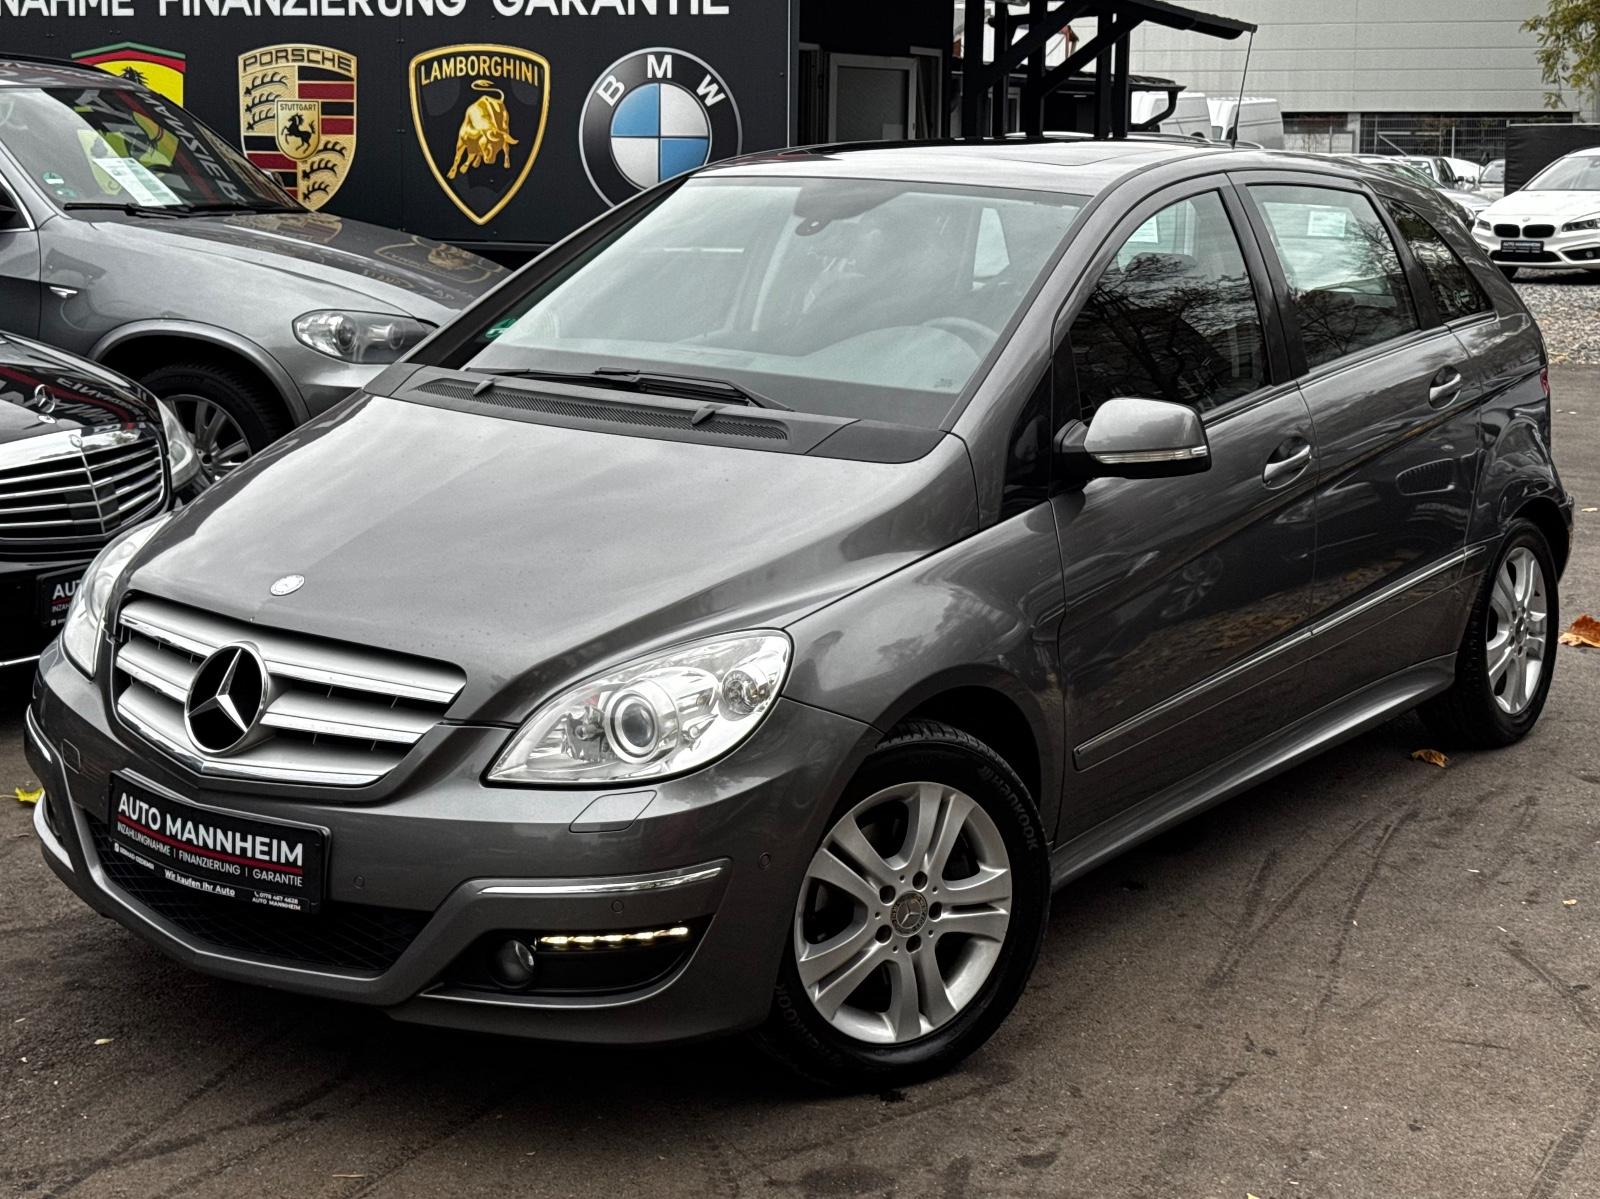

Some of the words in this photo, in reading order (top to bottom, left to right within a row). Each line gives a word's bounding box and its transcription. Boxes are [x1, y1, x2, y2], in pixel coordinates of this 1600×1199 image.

[243, 48, 353, 74] PORSCHE
[421, 55, 539, 87] LAMBORGHINI
[279, 103, 317, 112] STUTTGART
[118, 792, 161, 830] AUTO
[166, 813, 304, 867] MANNHEIM
[164, 868, 176, 881] Wir
[176, 873, 201, 890] kaufen
[215, 884, 236, 897] Auto
[178, 850, 241, 876] FINANZIERUNG
[252, 869, 303, 887] GARANTIE
[252, 897, 268, 905] AUTO
[268, 900, 302, 911] MANNHEIM
